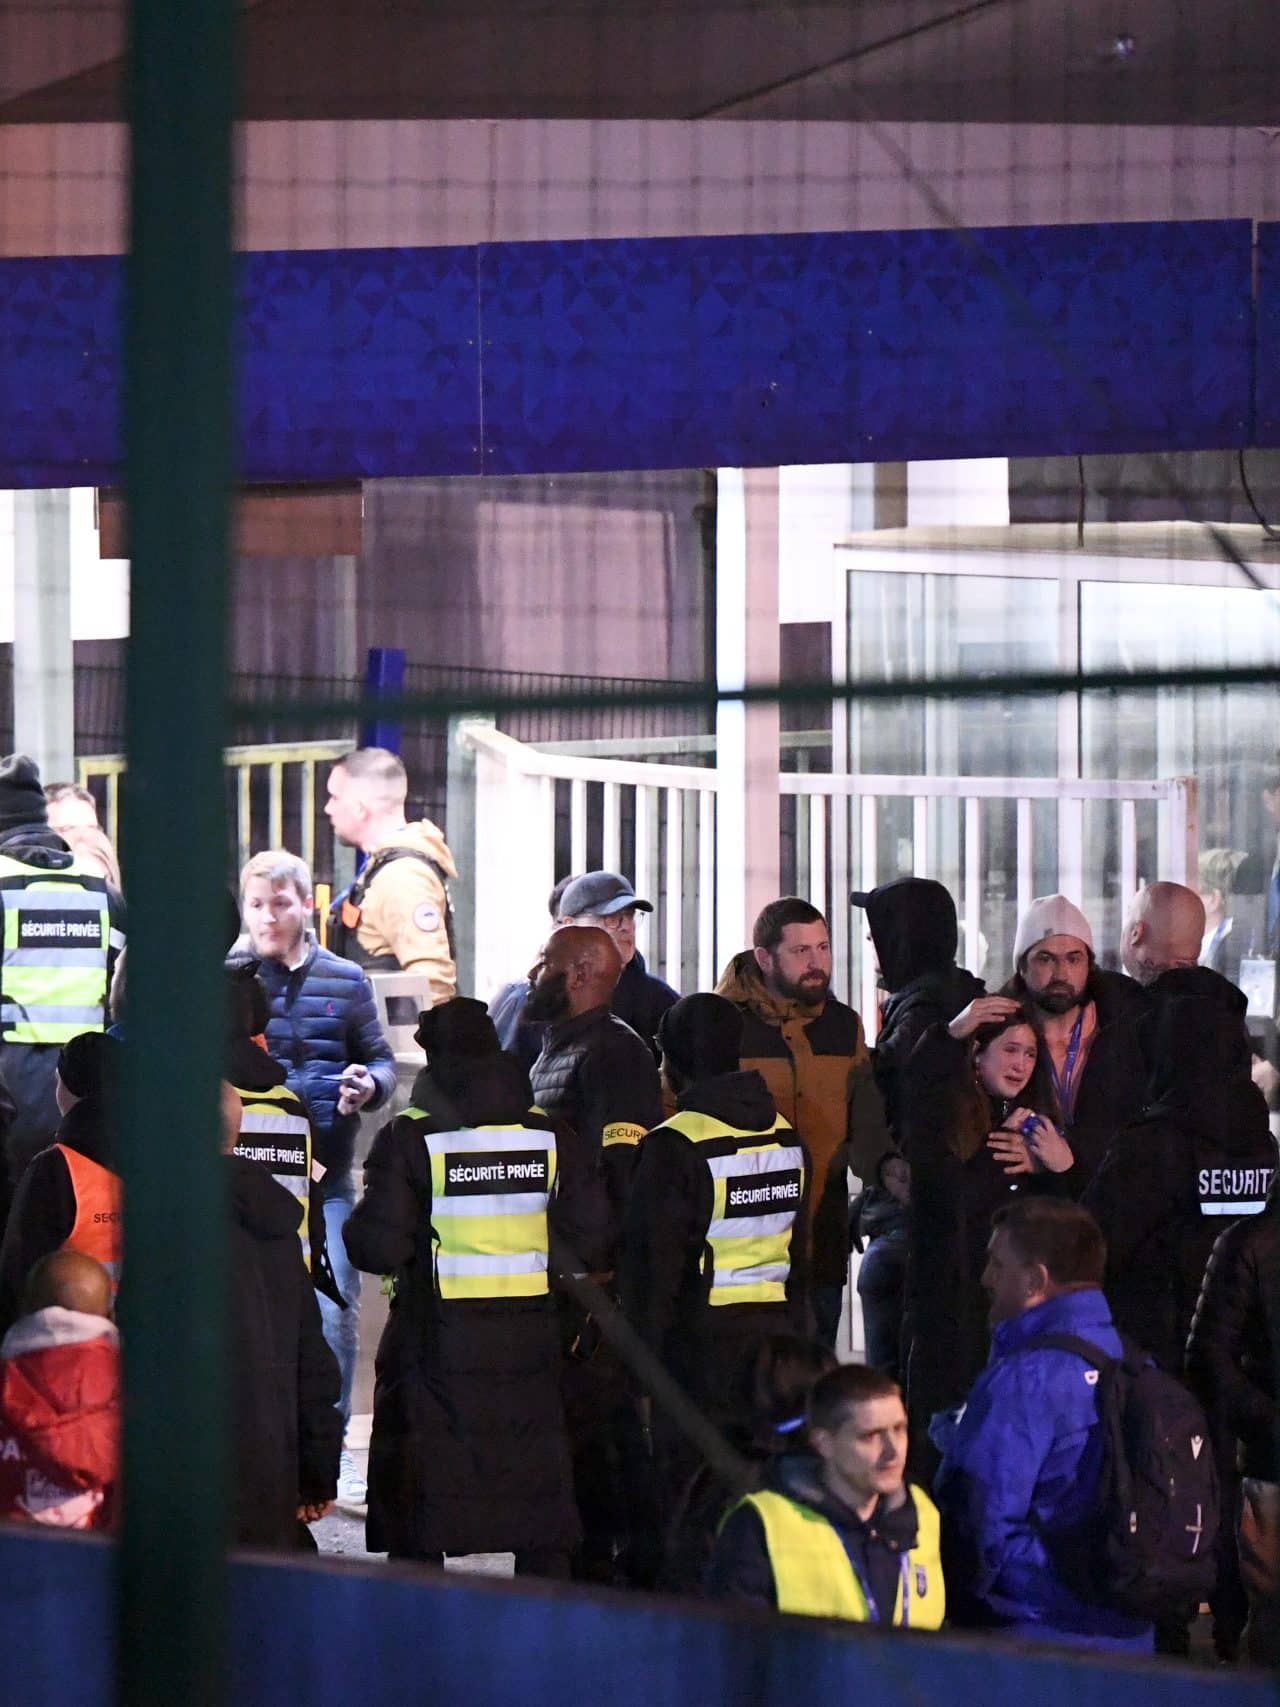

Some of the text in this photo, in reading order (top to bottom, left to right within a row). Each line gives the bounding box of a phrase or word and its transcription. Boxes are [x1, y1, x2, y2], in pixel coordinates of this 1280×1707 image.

[21, 919, 100, 938] SÉCURITÉ PRIVÉE
[277, 1146, 305, 1165] PRIVÉE
[449, 1160, 545, 1183] SÉCURITÉ PRIVÉE
[1199, 1168, 1274, 1195] SECURIT
[730, 1179, 799, 1206] SÉCURITÉ PRIVÉE
